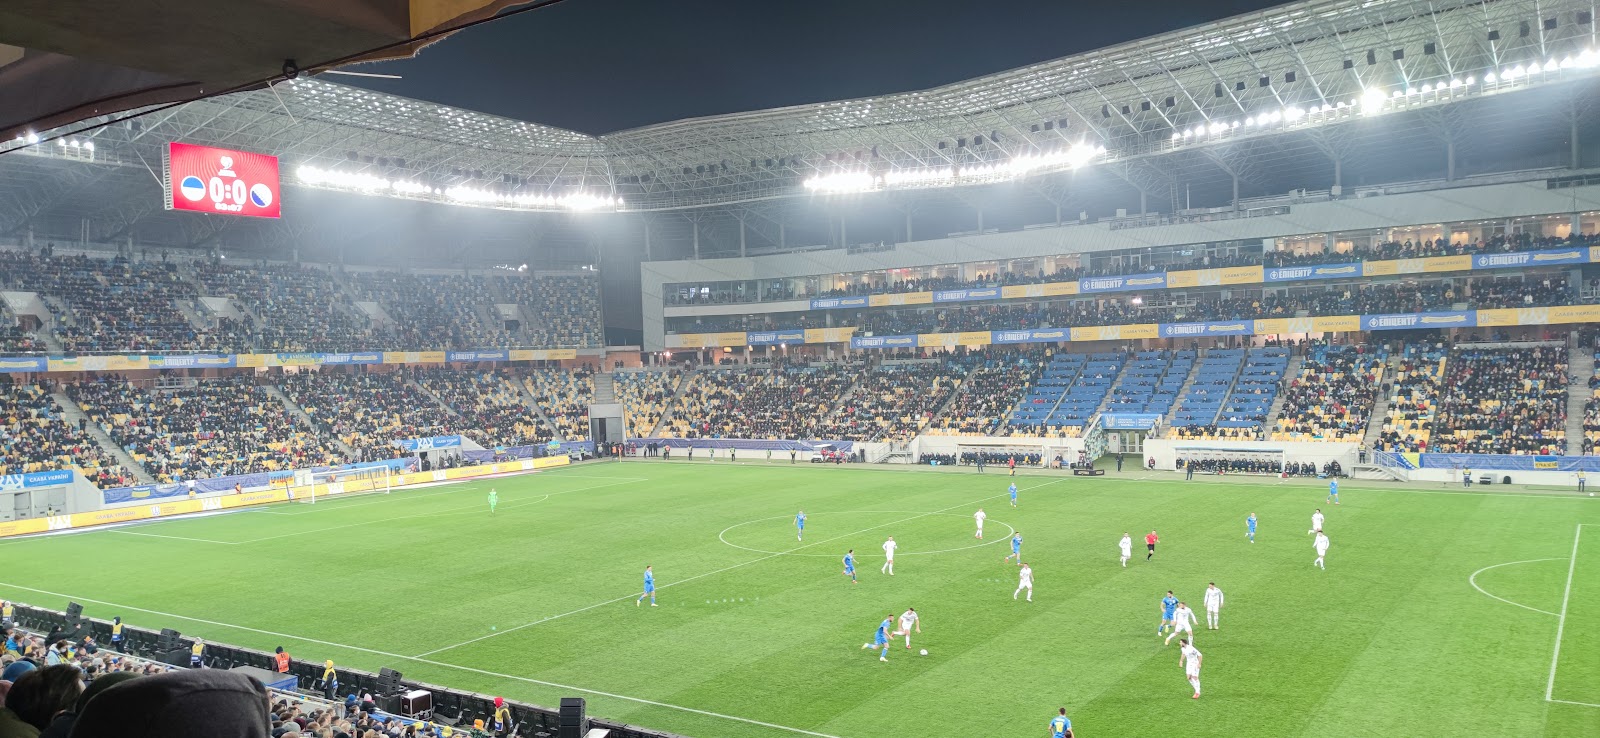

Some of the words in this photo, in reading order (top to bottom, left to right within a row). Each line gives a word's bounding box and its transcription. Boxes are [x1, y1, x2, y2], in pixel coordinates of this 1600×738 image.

[209, 176, 247, 205] 0:0
[1488, 254, 1529, 265] ЕПІЦЕНТР
[1278, 268, 1312, 278] ЕПІЦЕНТР
[1091, 279, 1122, 289] ЕПІЦЕНТР
[1378, 316, 1417, 327] ЕПІЦЕНТР
[1174, 325, 1205, 334] ЕПІЦЕНТР
[1004, 333, 1030, 341] ЕПІЦЕНТР
